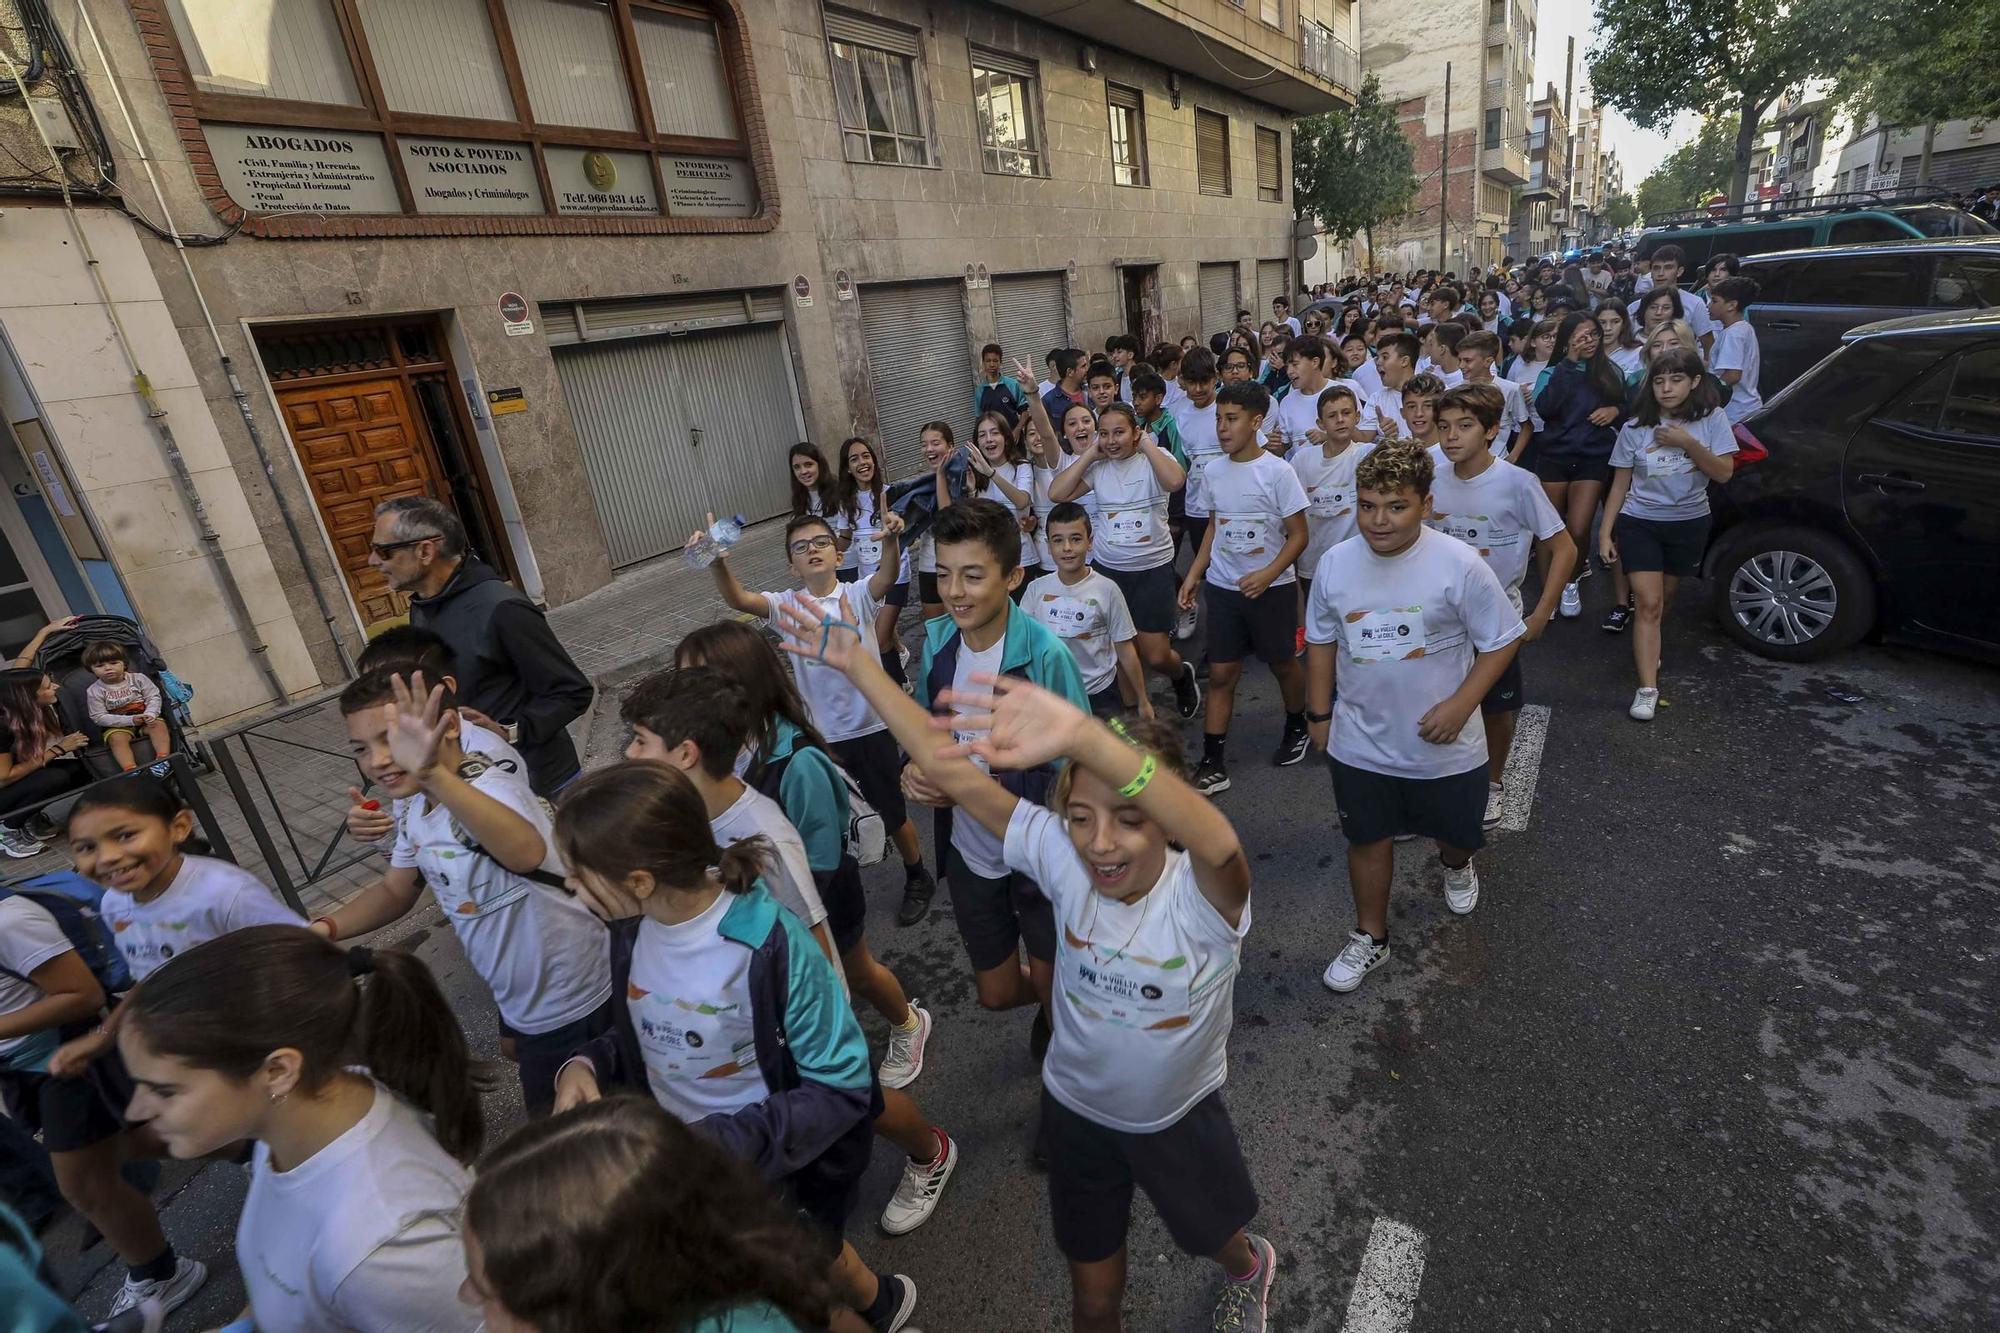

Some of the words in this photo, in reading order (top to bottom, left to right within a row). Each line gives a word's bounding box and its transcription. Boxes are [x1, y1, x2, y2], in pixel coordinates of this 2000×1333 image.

[245, 135, 353, 153] ABOGADOS
[410, 145, 450, 158] SOTO
[453, 148, 465, 159] &
[467, 148, 523, 161] POVEDA
[244, 158, 270, 168] Civil,
[272, 159, 308, 169] Familia
[309, 163, 314, 171] y
[316, 161, 361, 171] Herencias
[428, 162, 507, 175] ASOCIADOS
[674, 161, 722, 170] INFORMES
[304, 173, 310, 181] y
[312, 171, 375, 181] Administrativo
[253, 181, 301, 191] Propiedad
[303, 182, 351, 191] Horizontal
[257, 192, 284, 201] Penal
[425, 187, 467, 199] Abogados
[467, 191, 473, 200] y
[474, 188, 529, 200] Criminólogos
[563, 193, 587, 203] Telf.
[587, 194, 608, 203] 966
[609, 194, 626, 204] 931
[630, 195, 646, 204] 445
[260, 202, 307, 211] Protección
[324, 203, 351, 211] Datos
[345, 291, 361, 305] 13
[1109, 976, 1137, 990] VUELTA
[1113, 986, 1132, 997] COLE
